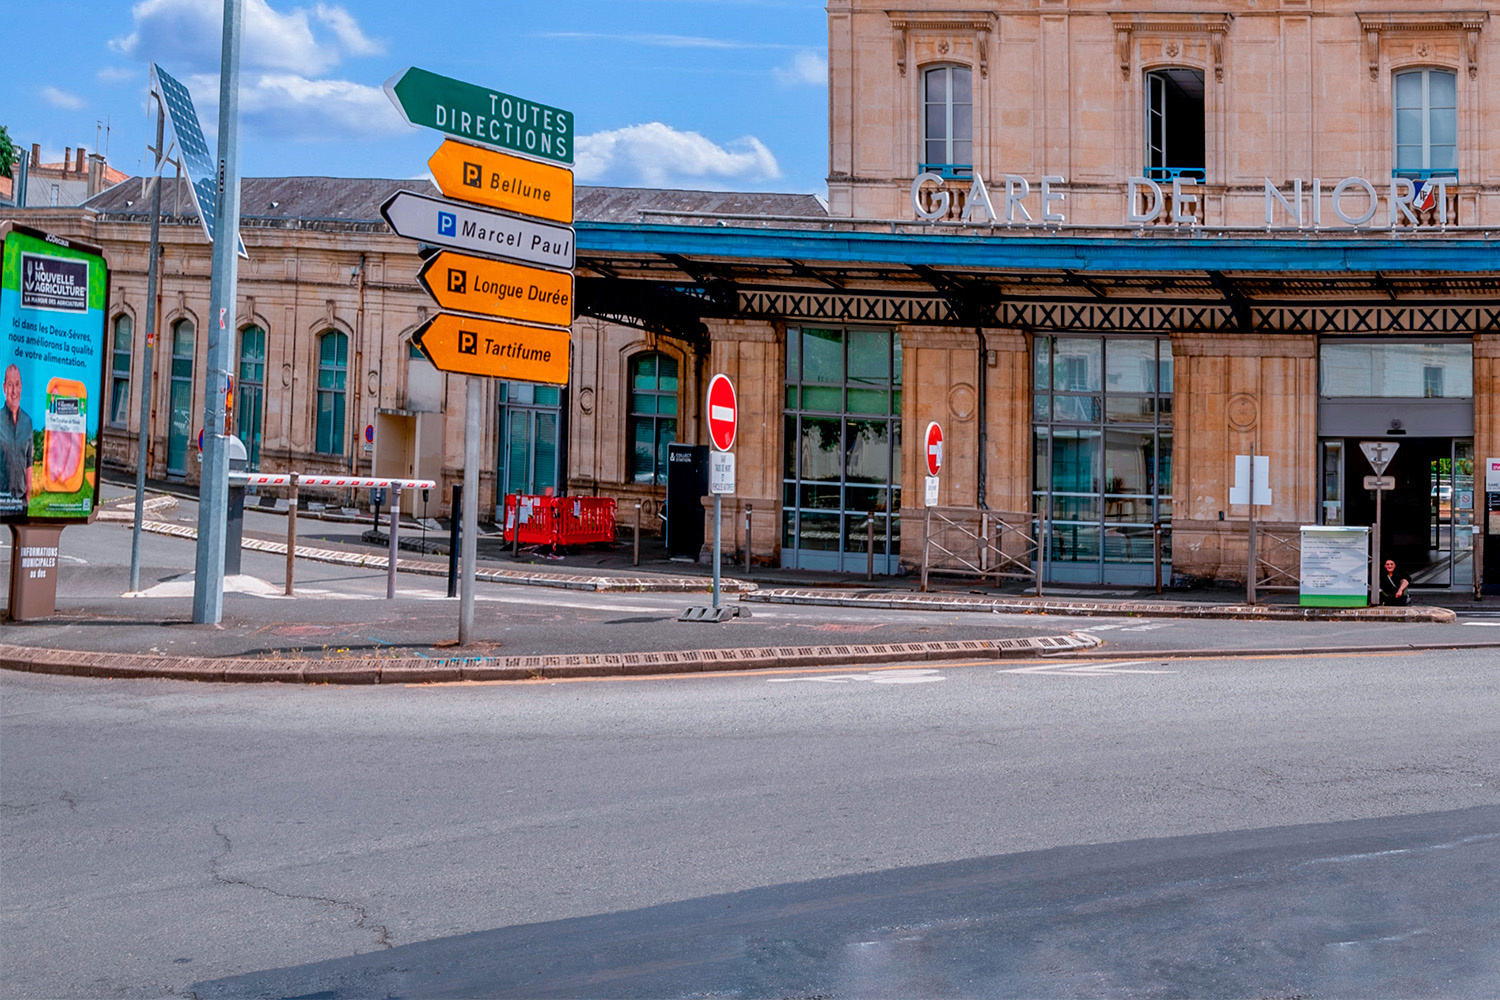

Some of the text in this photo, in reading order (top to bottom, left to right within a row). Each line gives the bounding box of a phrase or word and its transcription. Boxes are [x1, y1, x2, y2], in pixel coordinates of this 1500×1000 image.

[489, 93, 567, 134] TOUTES
[436, 104, 567, 158] DIRECTIONS
[490, 172, 551, 202] Bellune
[911, 172, 1458, 227] GARE DE NIORT
[462, 220, 522, 247] Marcel
[530, 235, 569, 256] Paul
[35, 261, 44, 271] LA
[34, 281, 85, 297] AGRICULTURE
[35, 271, 74, 285] NOUVELLE
[474, 276, 523, 300] Longue
[528, 285, 569, 305] Durée
[12, 317, 20, 328] Ici
[21, 319, 38, 332] dans
[38, 322, 48, 334] les
[8, 332, 94, 356] nous améliorons la qualité
[484, 338, 552, 363] Tartifume
[14, 346, 87, 368] de votre alimentation.
[21, 547, 58, 557] INFORMATIONS
[22, 557, 56, 568] MUNICIPALES
[30, 568, 46, 578] au dos
